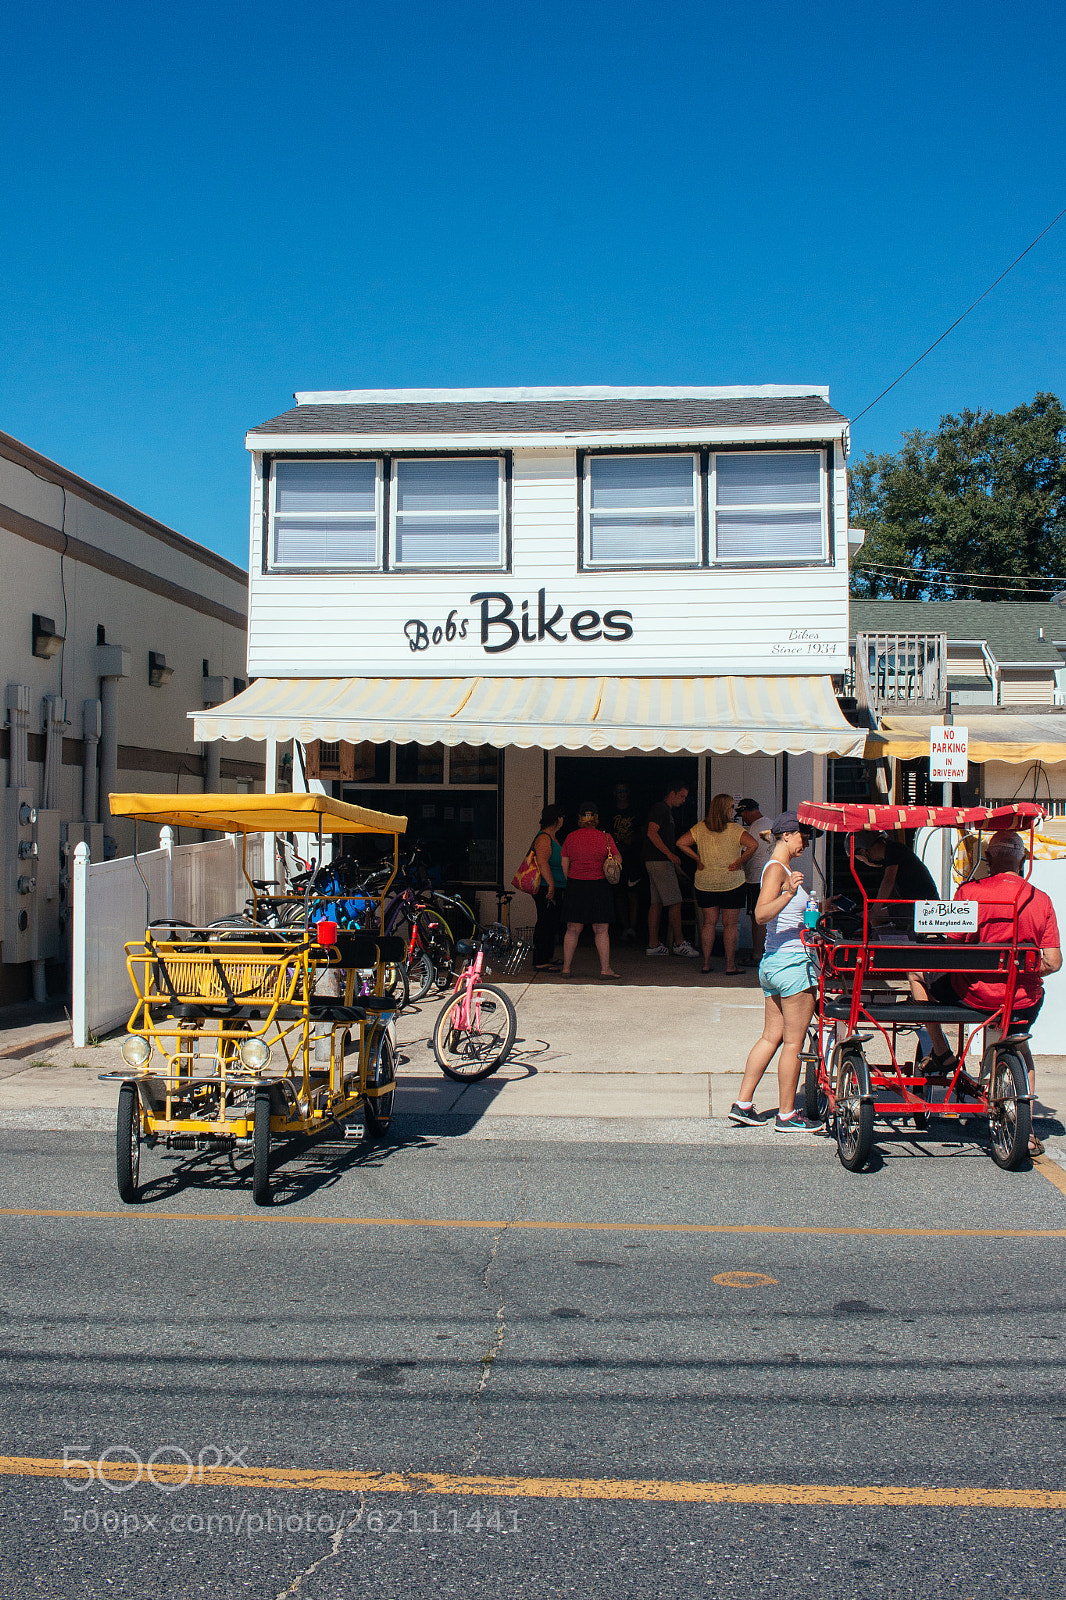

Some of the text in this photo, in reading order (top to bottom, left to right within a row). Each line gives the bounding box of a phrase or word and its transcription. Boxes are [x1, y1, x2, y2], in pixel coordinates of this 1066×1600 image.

[470, 587, 634, 654] Bikes
[788, 629, 819, 641] Bikes
[771, 643, 837, 654] Since 1934
[943, 729, 955, 740] NO
[932, 742, 967, 753] PARKING
[945, 757, 953, 766] IN
[932, 768, 965, 777] DRIVEWAY
[937, 902, 970, 916] Bikes
[934, 919, 961, 927] Maryland
